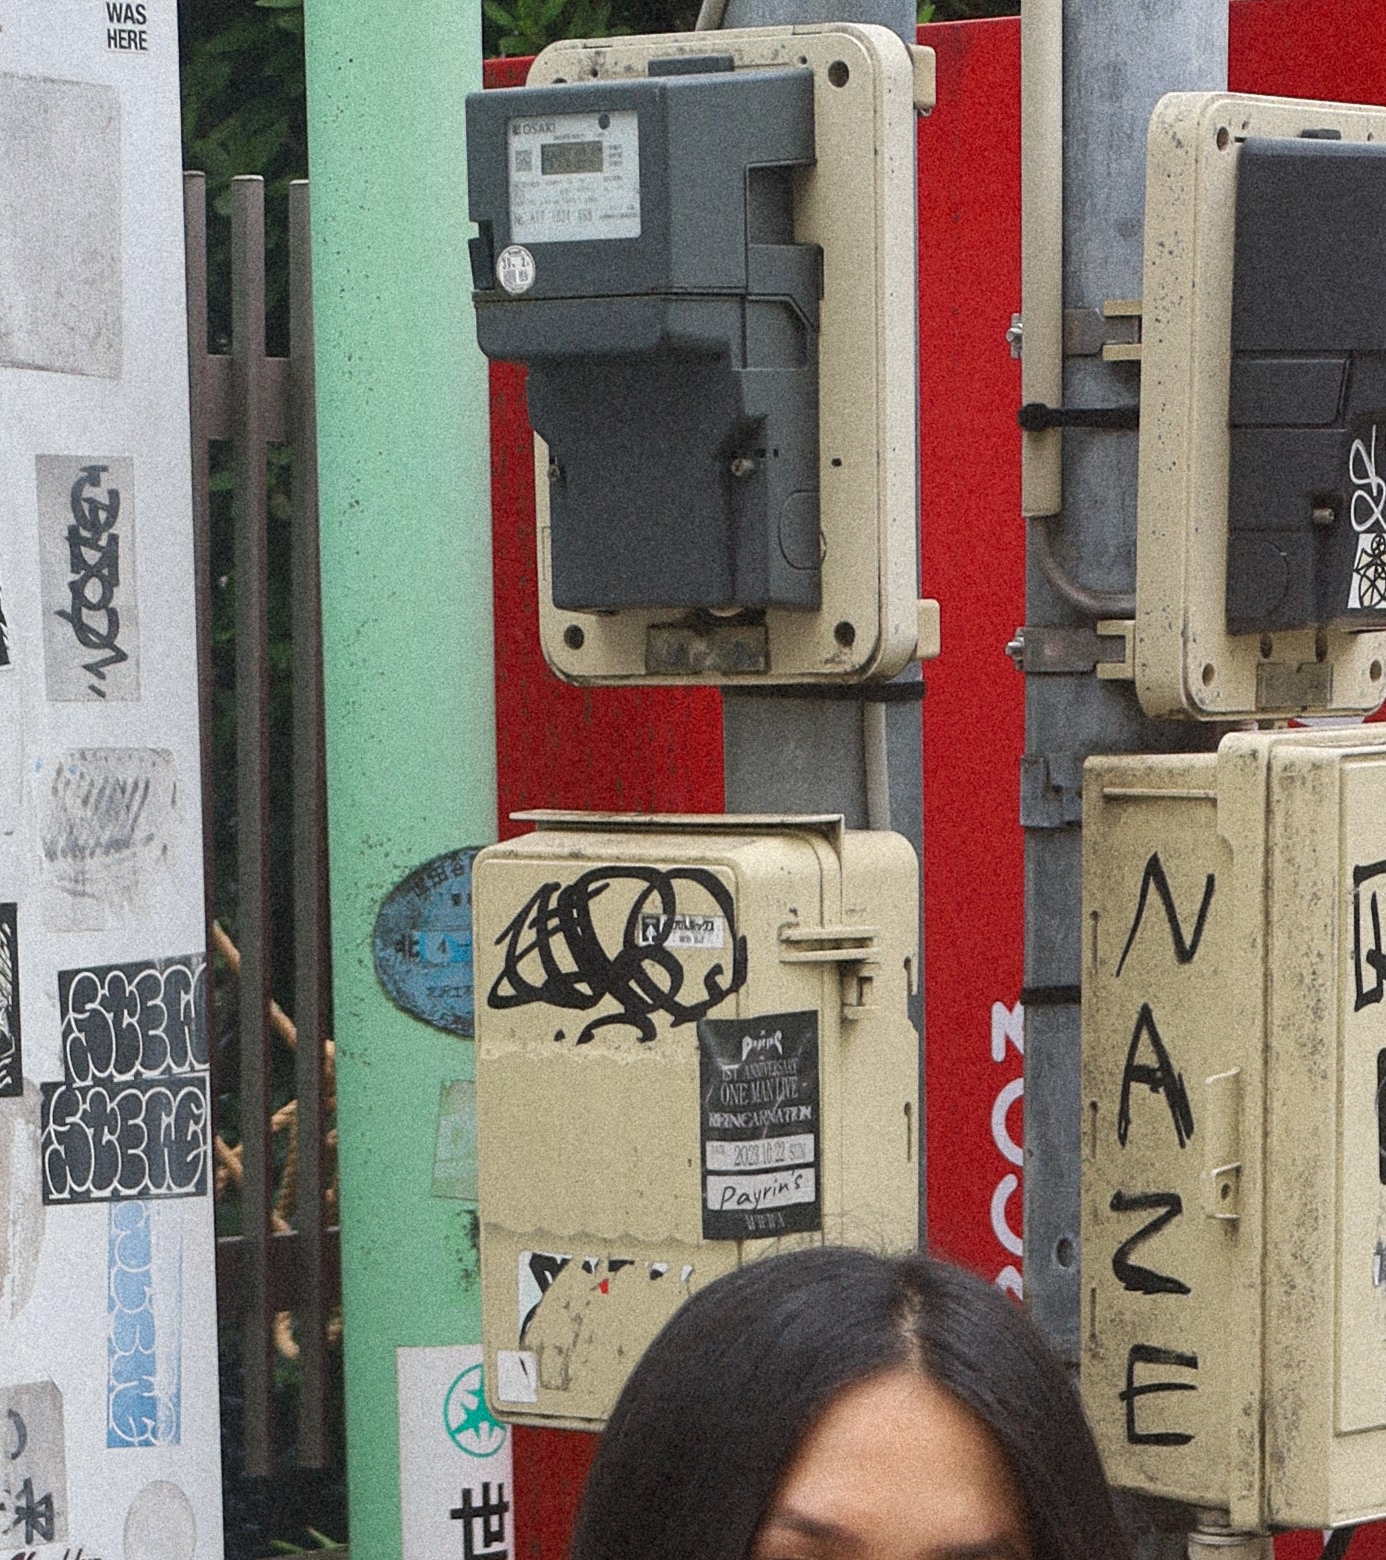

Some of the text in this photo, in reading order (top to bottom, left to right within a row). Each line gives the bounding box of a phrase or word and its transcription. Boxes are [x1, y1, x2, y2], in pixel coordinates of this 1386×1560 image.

[106, 1, 148, 25] WAS
[106, 27, 149, 51] HERE
[719, 1075, 798, 1107] ONE MAN LIVE
[1112, 850, 1216, 1448] NAZE
[720, 1169, 804, 1212] Payrin's
